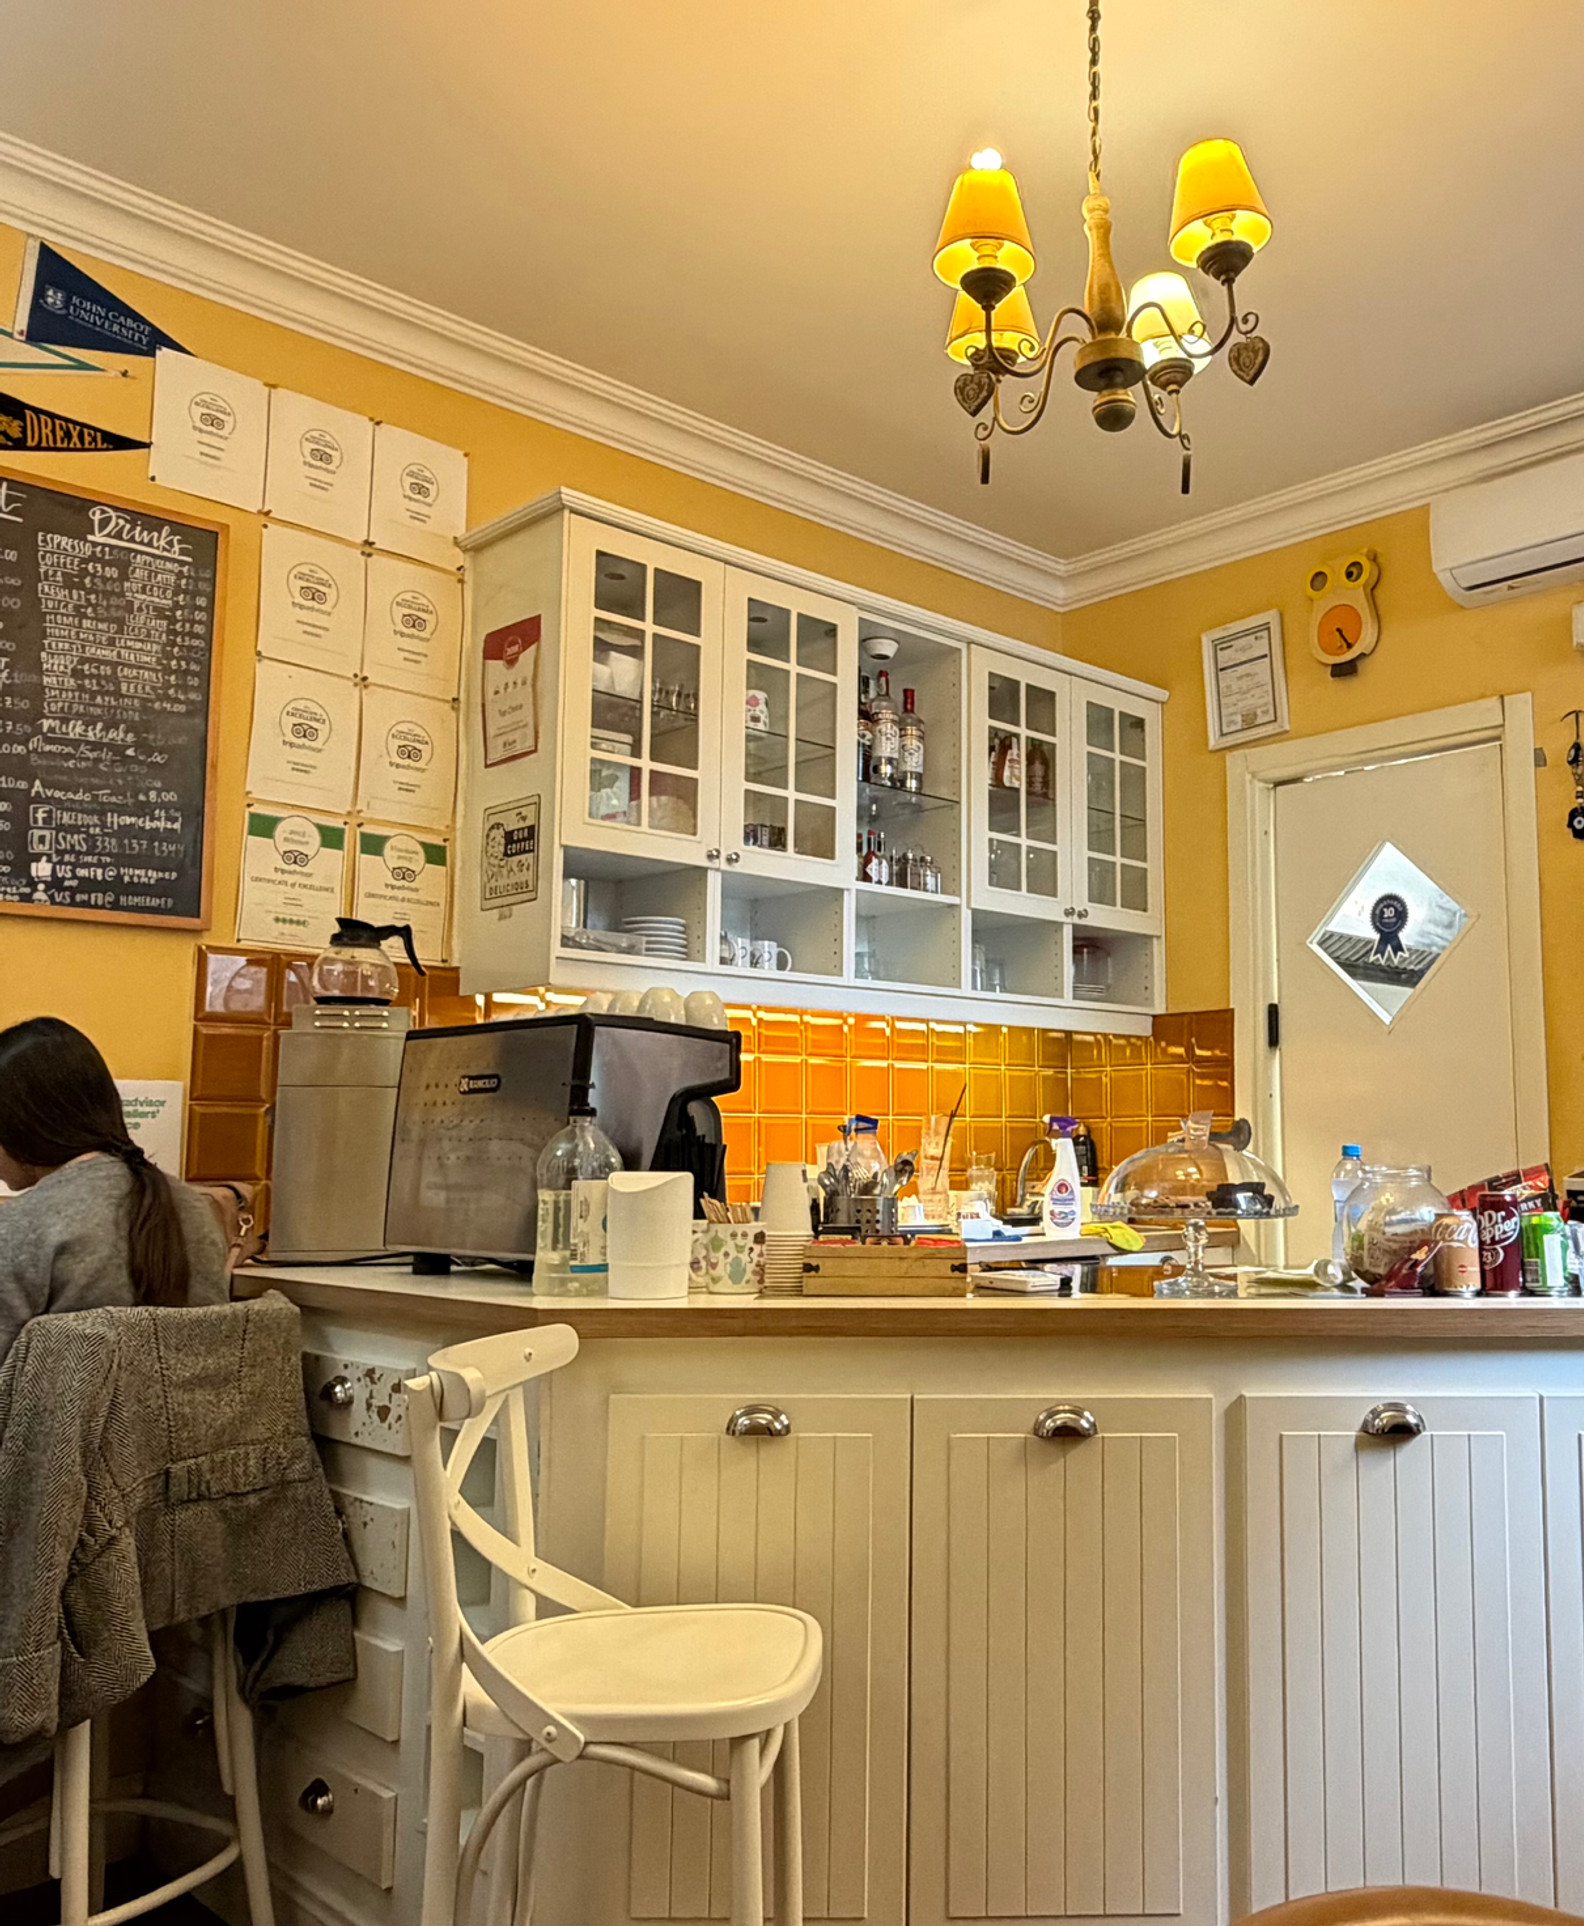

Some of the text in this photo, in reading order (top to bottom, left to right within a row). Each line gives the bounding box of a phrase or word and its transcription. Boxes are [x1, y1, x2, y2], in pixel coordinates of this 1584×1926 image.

[71, 295, 107, 317] JOHN
[108, 311, 152, 335] CABOT
[69, 305, 150, 346] UNIVERSITY
[25, 410, 108, 448] DREXEL
[88, 506, 192, 555] Drinks
[38, 532, 92, 556] ESPRESSO
[38, 551, 80, 571] COFFEE
[41, 599, 74, 613] JUICE
[46, 614, 79, 628] HOME
[31, 779, 92, 801] Avocado
[56, 832, 88, 852] SMS
[94, 836, 118, 853] 338
[507, 839, 534, 855] COFFEE
[56, 865, 72, 878] US
[489, 879, 530, 896] DELICIOUS
[54, 891, 71, 904] US
[1383, 906, 1395, 918] 10
[121, 1096, 167, 1108] advisor
[1518, 1198, 1542, 1212] RKY
[1484, 1210, 1505, 1231] Dr
